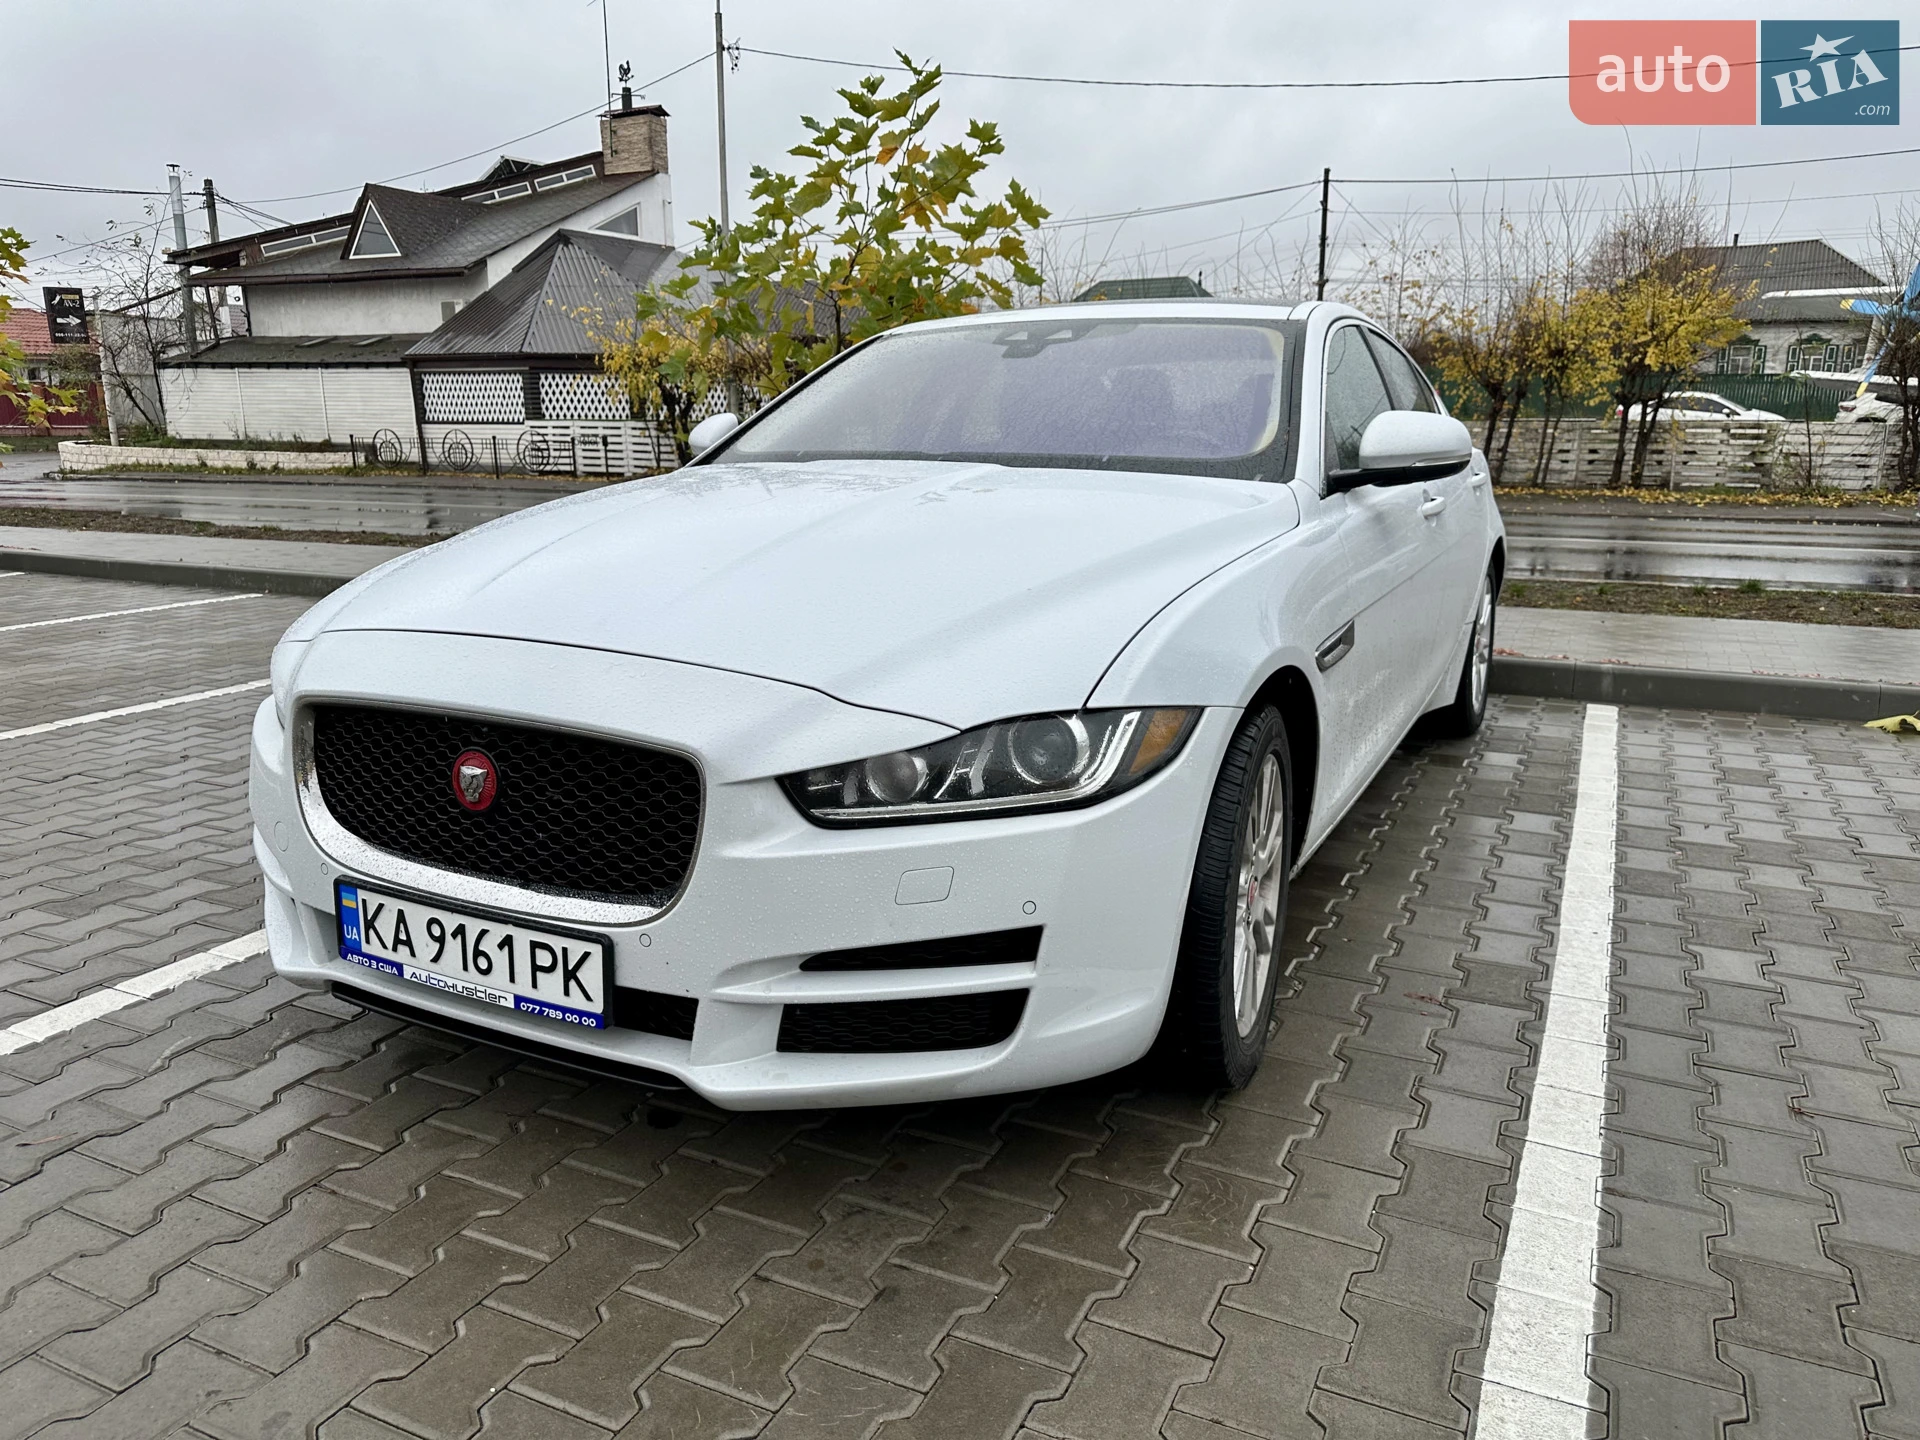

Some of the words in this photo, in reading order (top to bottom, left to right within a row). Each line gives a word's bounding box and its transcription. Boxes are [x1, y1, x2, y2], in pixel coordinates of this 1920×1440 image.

[344, 924, 359, 941] UA
[361, 898, 416, 957] KA
[425, 916, 515, 984] 9161
[530, 939, 593, 1002] PK
[347, 953, 369, 967] АВТО
[379, 963, 399, 975] США
[520, 1002, 539, 1013] 077
[542, 1007, 563, 1019] 789
[565, 1012, 580, 1024] 00
[581, 1016, 596, 1027] 00
